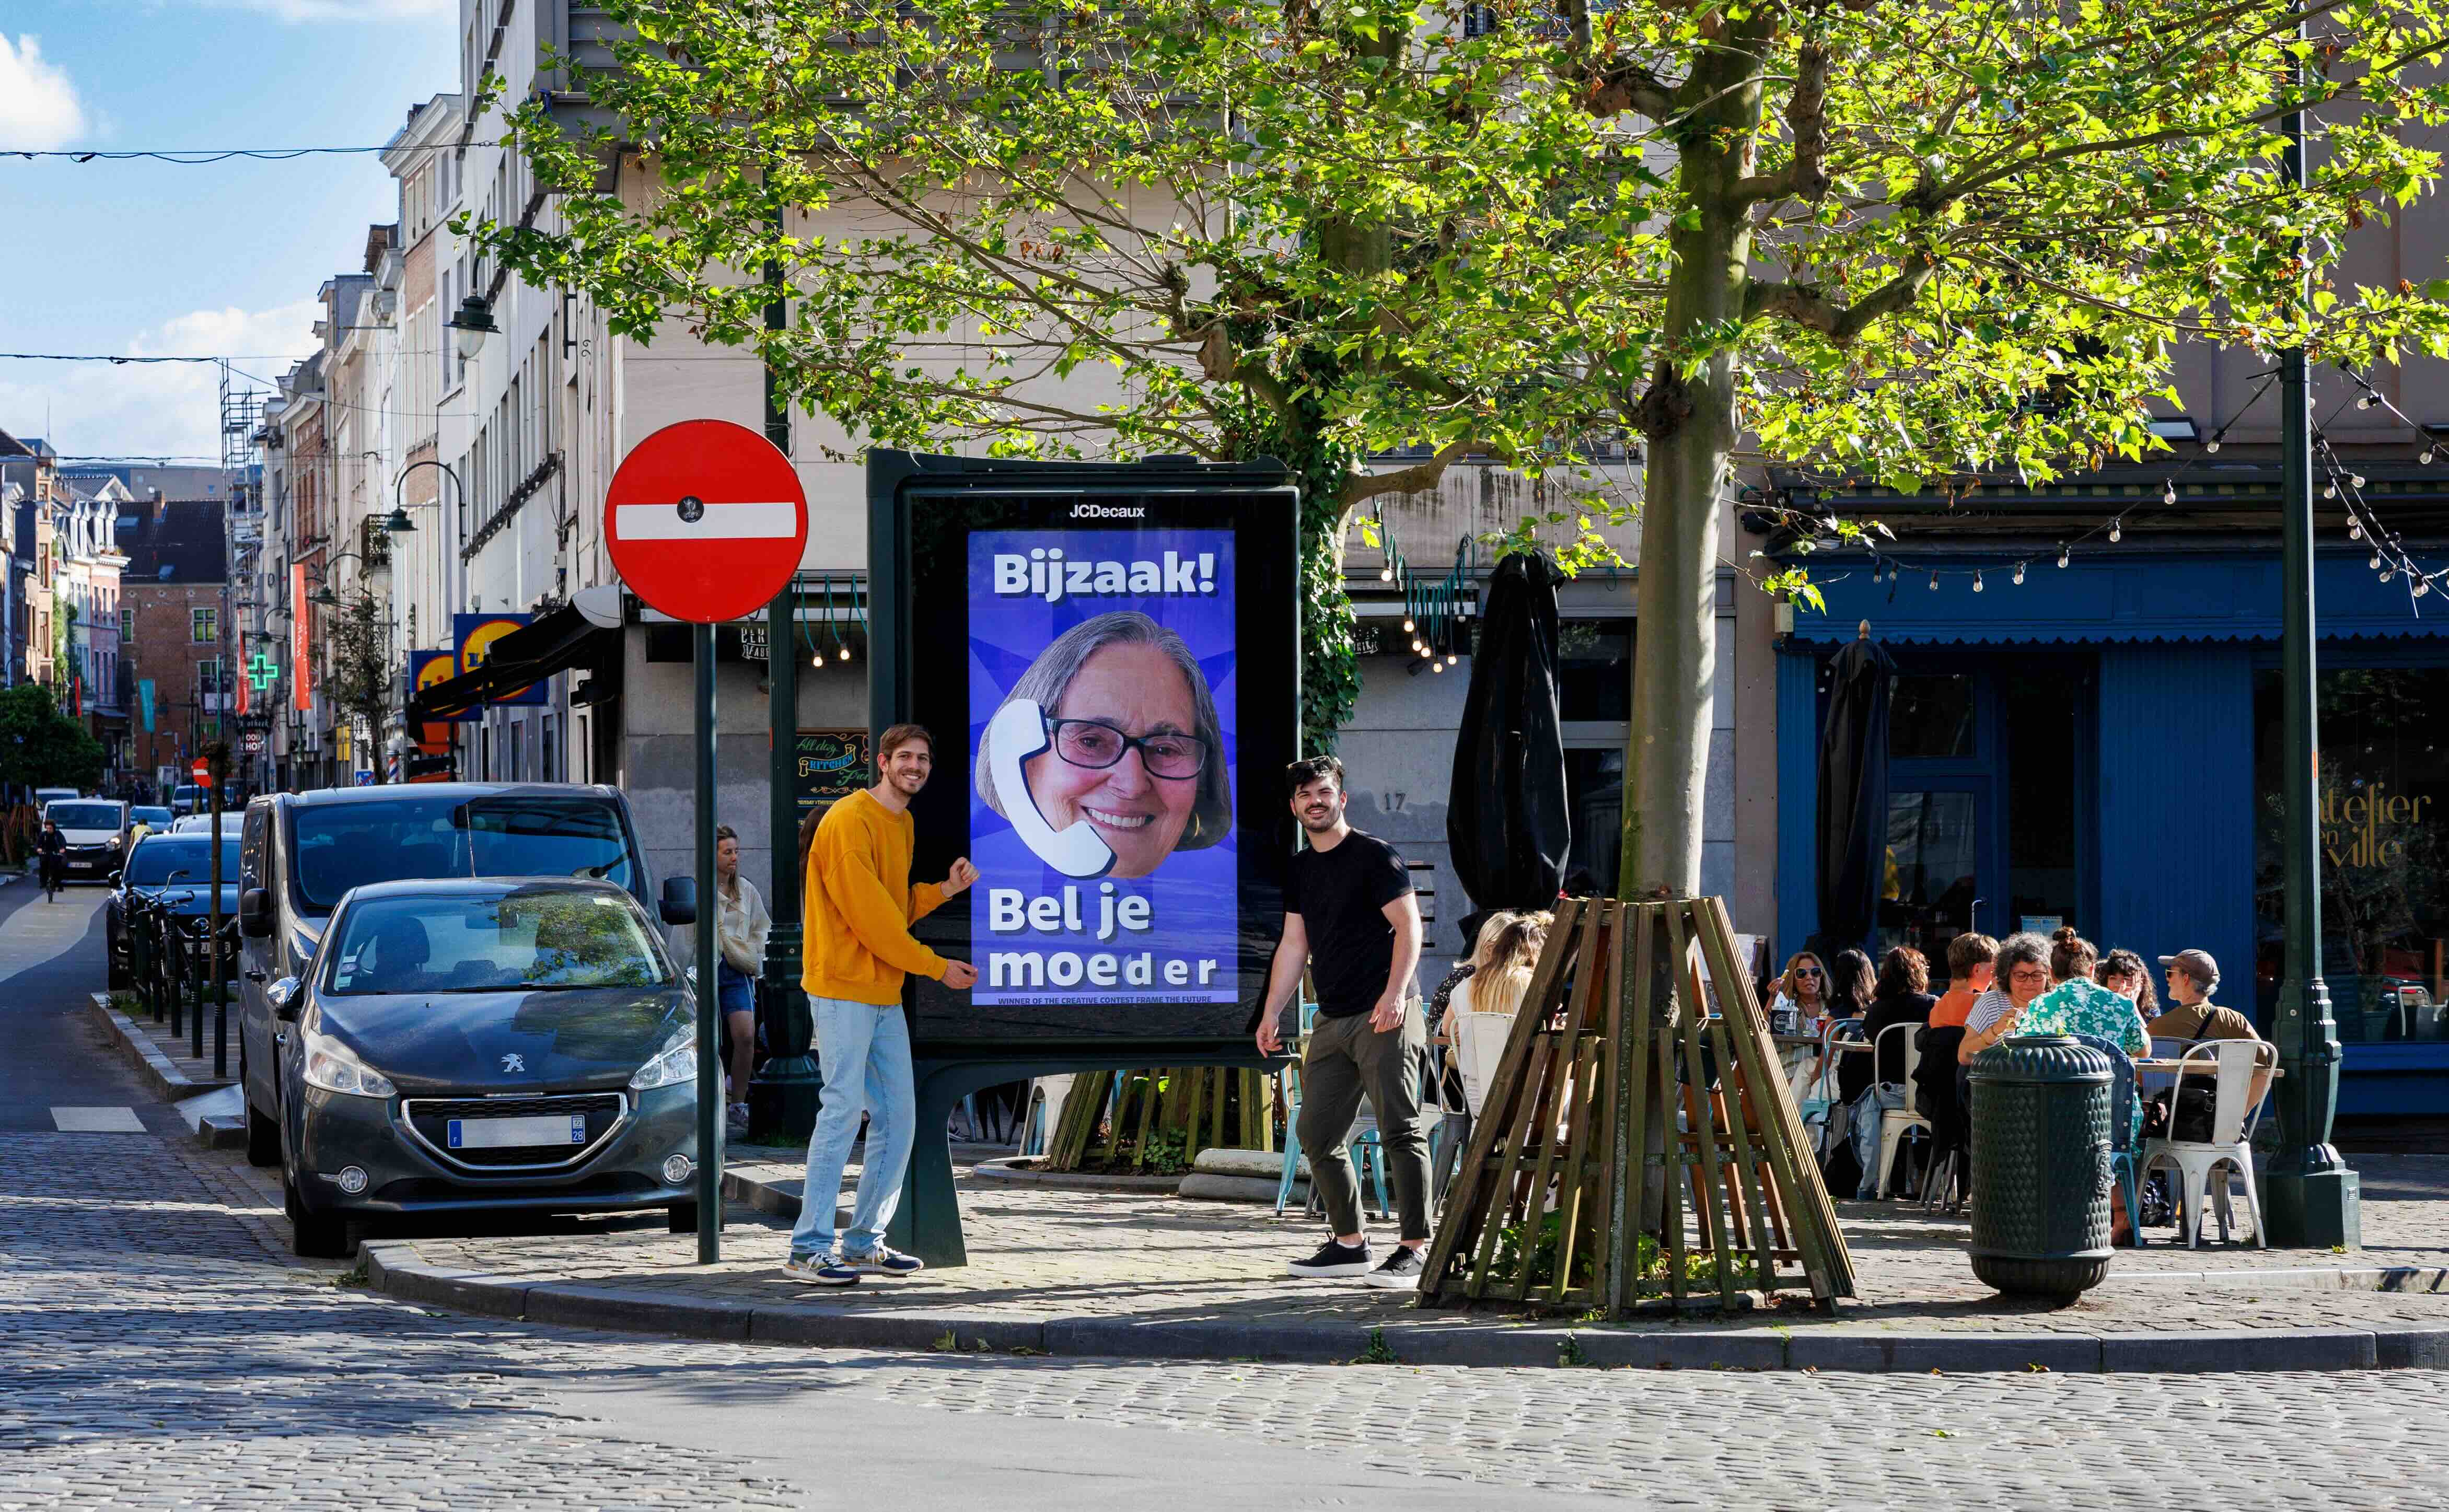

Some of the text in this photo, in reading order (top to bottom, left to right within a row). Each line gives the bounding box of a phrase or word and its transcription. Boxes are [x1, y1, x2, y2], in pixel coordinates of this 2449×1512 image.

[1070, 504, 1145, 518] JCDecaux
[994, 548, 1214, 602] Bijzaak!
[810, 752, 853, 770] KITCHEN
[1385, 793, 1406, 810] 17
[2327, 827, 2404, 868] ville
[990, 882, 1150, 940] Bel je
[573, 1131, 584, 1141] 28
